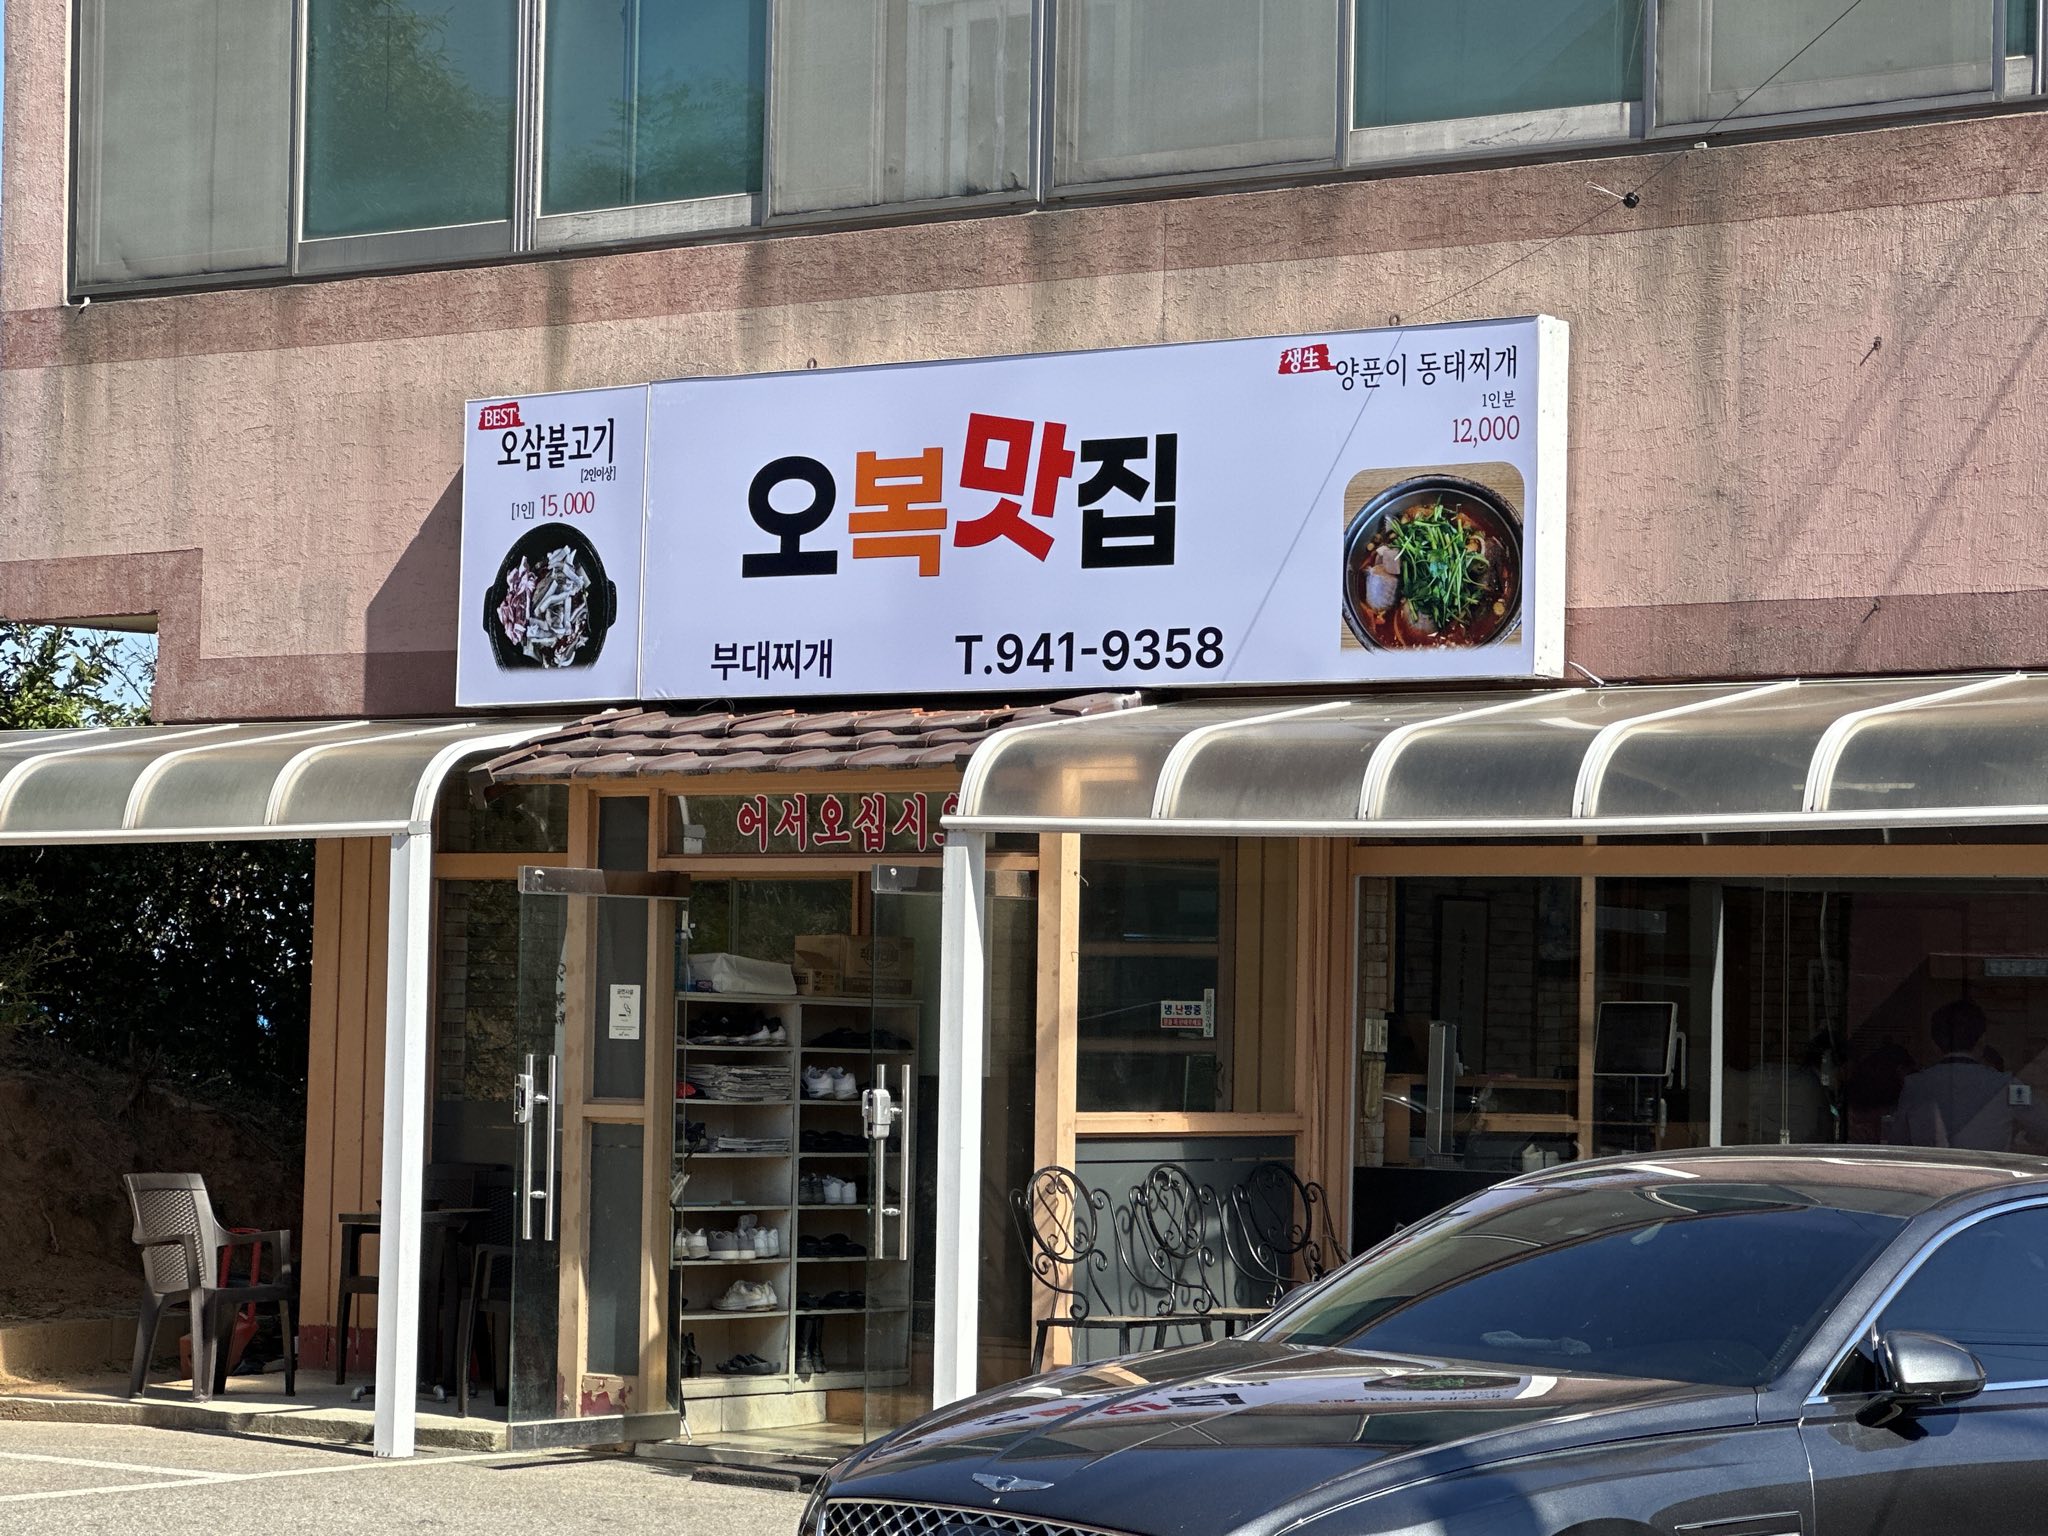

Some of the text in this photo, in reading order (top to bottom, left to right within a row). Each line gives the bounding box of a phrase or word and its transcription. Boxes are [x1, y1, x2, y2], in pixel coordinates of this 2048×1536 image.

[1335, 353, 1407, 391] 양푼이
[1416, 345, 1517, 386] 동태찌개
[484, 407, 517, 427] BEST
[1482, 390, 1517, 409] 1인분
[497, 418, 615, 472] 오삼불고기
[1452, 415, 1520, 449] 12,000
[580, 465, 617, 483] [2인이상]
[511, 501, 535, 521] [1인]
[742, 413, 1178, 578] 오복맛집
[710, 638, 833, 680] 부대찌개
[955, 626, 1225, 675] T.941-9358
